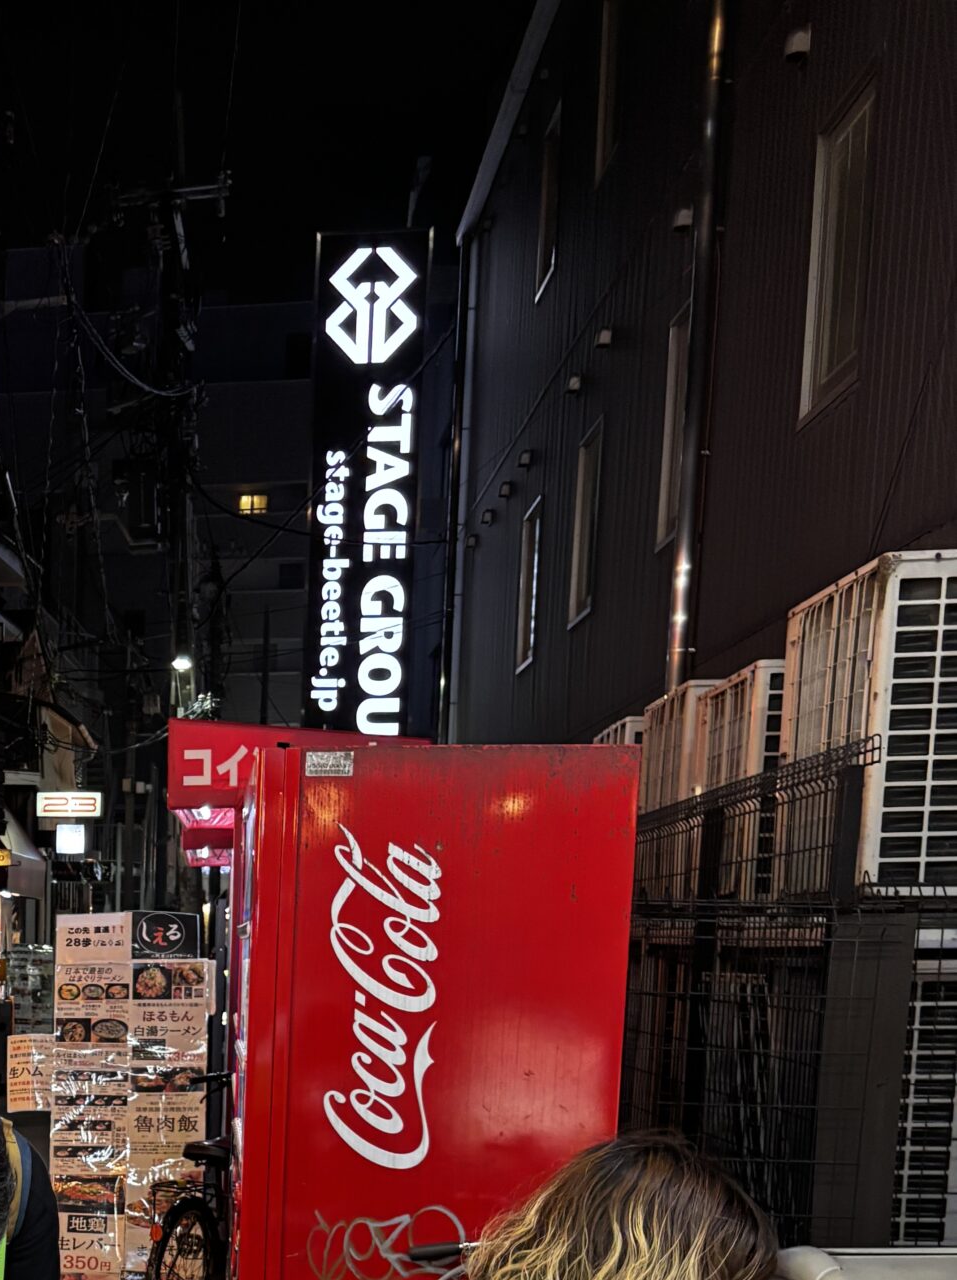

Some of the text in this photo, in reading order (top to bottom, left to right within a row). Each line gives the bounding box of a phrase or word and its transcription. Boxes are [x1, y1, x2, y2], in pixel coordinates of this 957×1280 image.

[362, 383, 416, 563] STAGE
[311, 450, 350, 712] stage-beetle.jp
[182, 744, 259, 787] コイ
[142, 920, 182, 947] しえる
[323, 823, 443, 1169] Coca-Cola
[142, 1010, 194, 1023] ほるもん
[133, 1025, 203, 1038] 白湯ラーメン
[9, 1066, 43, 1079] 生ハム
[69, 1216, 106, 1233] 地鶏
[63, 1255, 112, 1271] 350円
